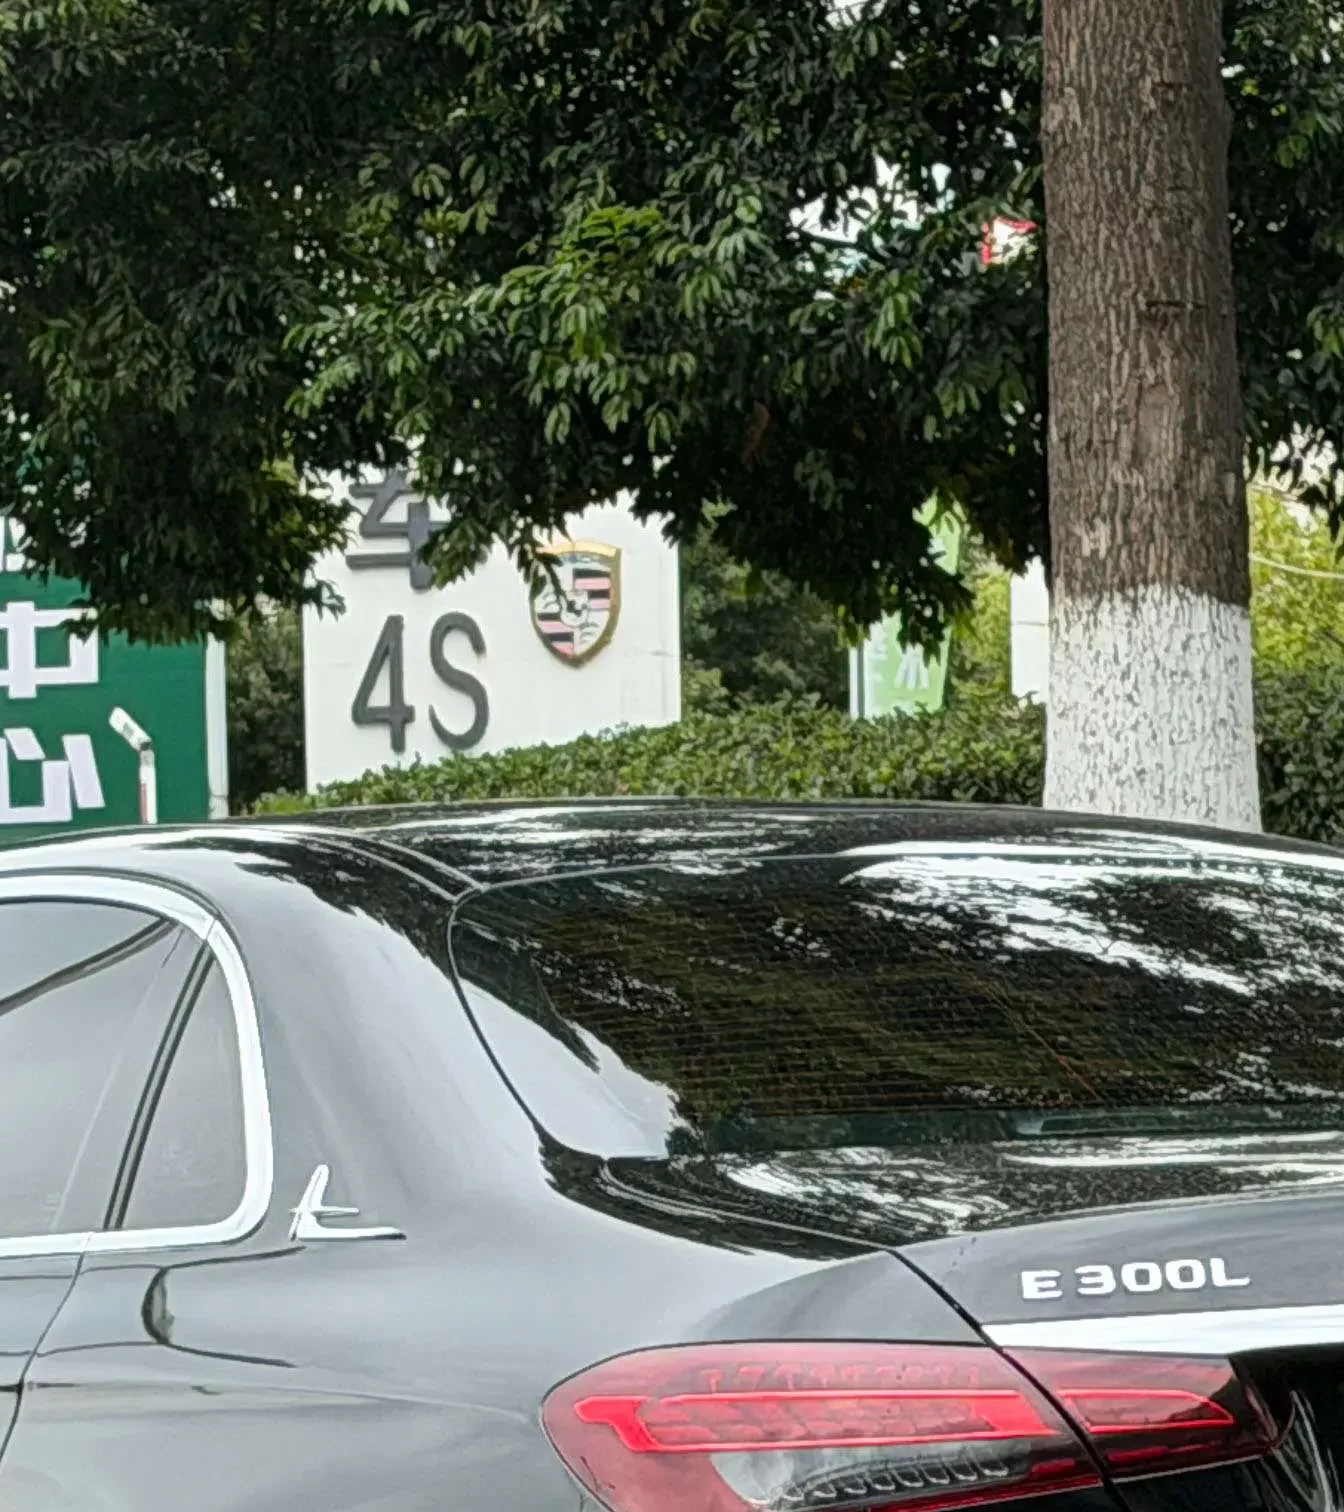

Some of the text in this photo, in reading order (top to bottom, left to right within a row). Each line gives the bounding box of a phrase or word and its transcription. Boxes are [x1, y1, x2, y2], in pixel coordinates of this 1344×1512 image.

[351, 612, 490, 755] 4S
[1021, 1257, 1252, 1300] E 300L
